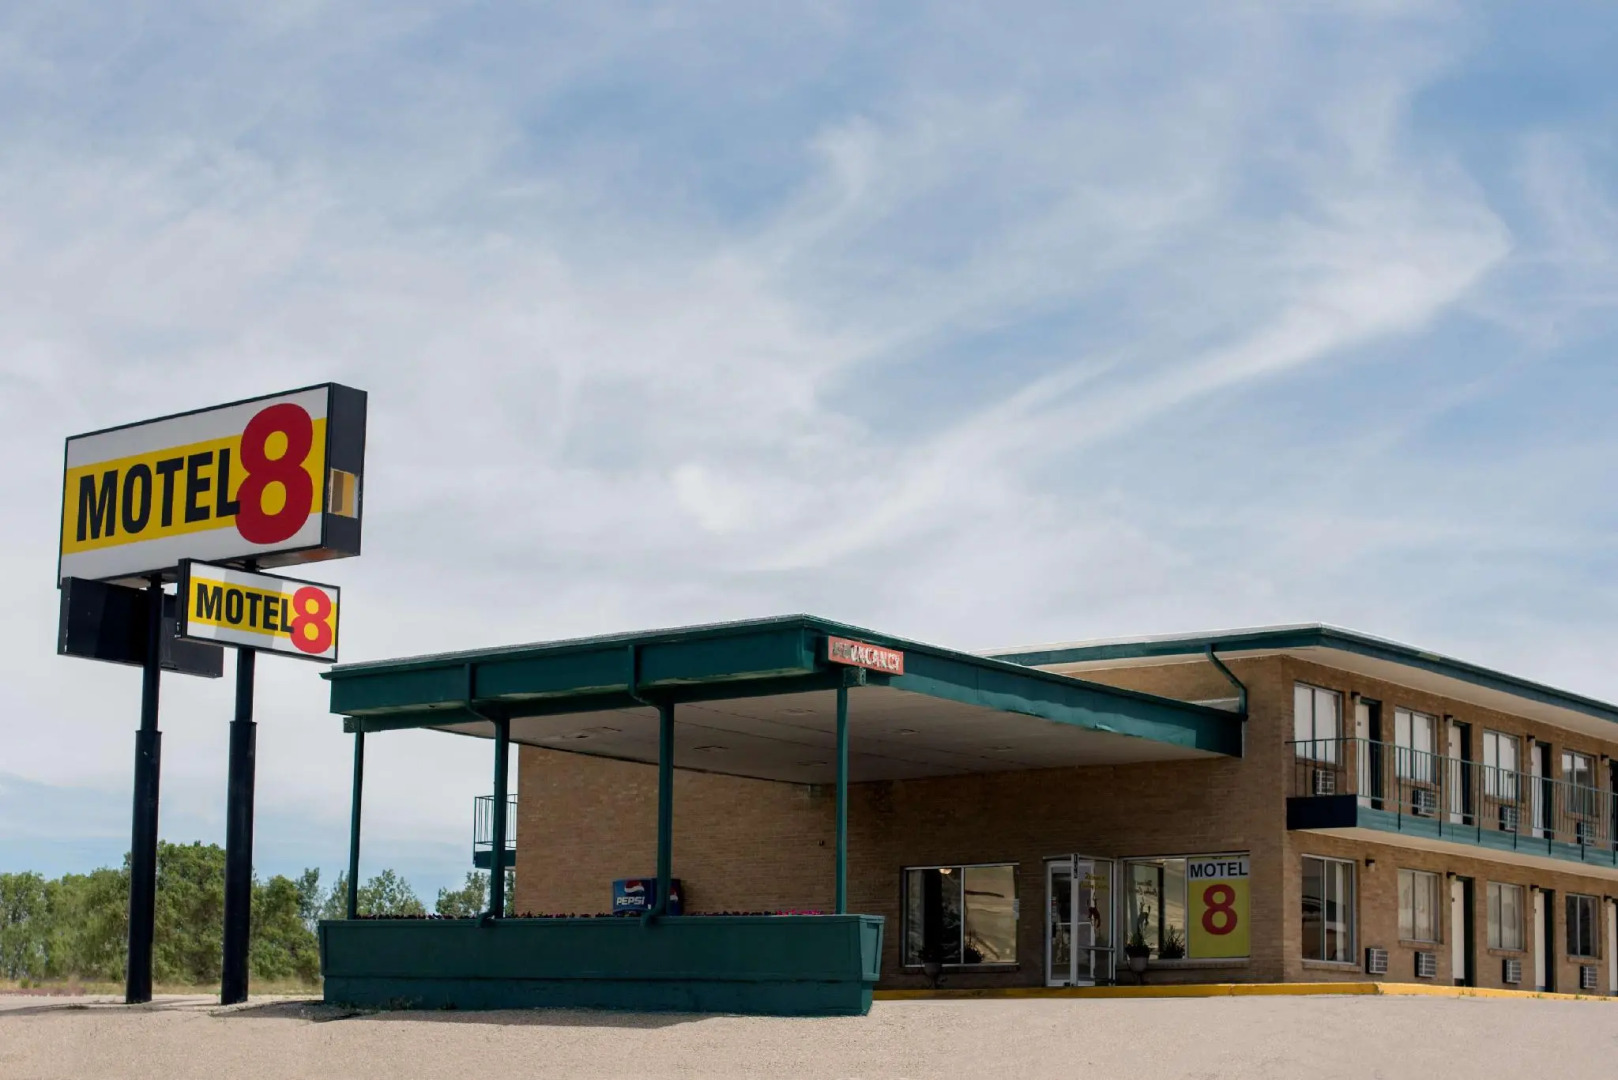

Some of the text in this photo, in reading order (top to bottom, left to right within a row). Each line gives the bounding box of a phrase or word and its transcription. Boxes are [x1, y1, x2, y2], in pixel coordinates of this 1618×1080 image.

[76, 402, 314, 545] MOTEL 8
[195, 582, 332, 654] MOTEL 8
[1190, 862, 1248, 878] MOTEL
[616, 896, 646, 906] PEPSI
[1202, 883, 1238, 936] 8
